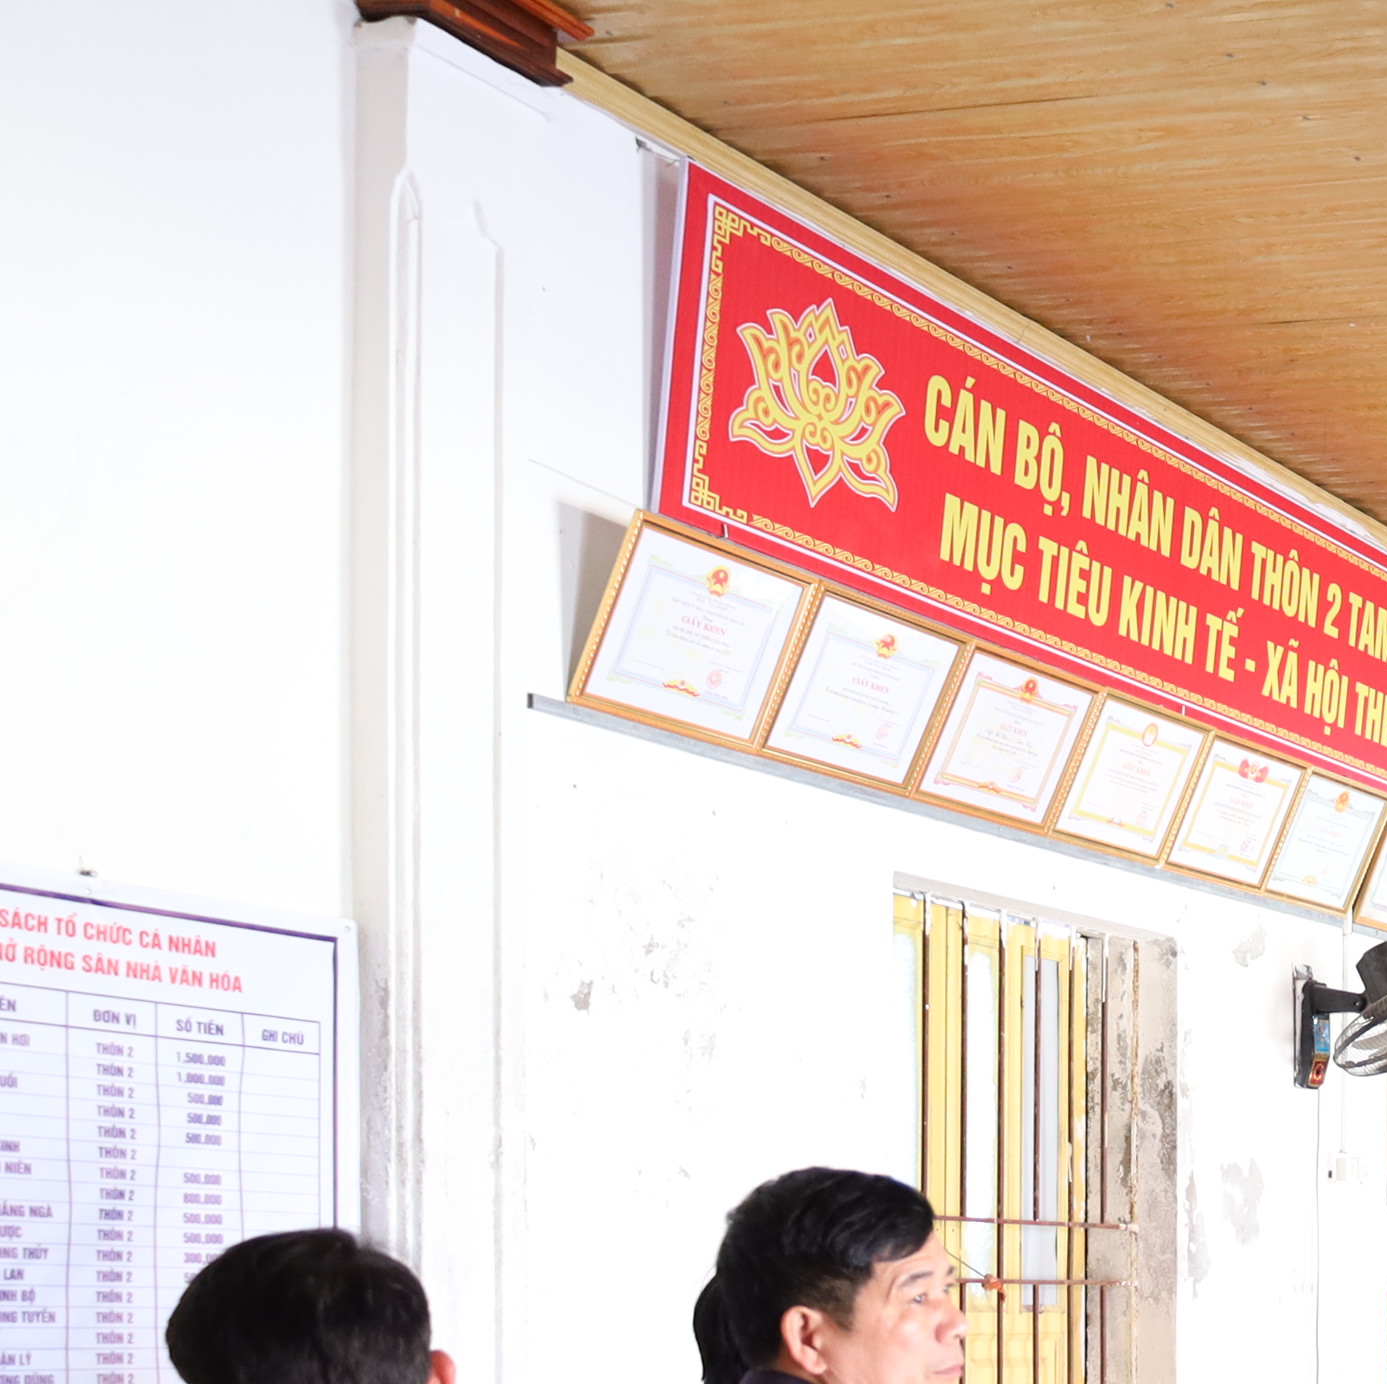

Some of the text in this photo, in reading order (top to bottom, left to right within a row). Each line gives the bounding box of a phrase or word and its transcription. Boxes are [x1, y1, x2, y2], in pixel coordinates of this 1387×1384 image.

[924, 376, 1006, 474] CÁN
[1014, 422, 1071, 517] BỘ,
[1082, 456, 1174, 556] NHÂN
[1181, 507, 1243, 589] DÂN
[1251, 542, 1320, 626] THÔN
[1324, 583, 1342, 637] 2
[940, 494, 1026, 593] MỤC
[1039, 537, 1112, 625] TIÊU
[1119, 576, 1197, 663] KINH
[1206, 609, 1243, 680] TẾ
[1262, 639, 1299, 707] XÃ
[1304, 659, 1349, 734] HỘI
[24, 944, 243, 993] RỘNG SÂN NHÀ VĂN HÓA
[55, 913, 77, 938] TỔ
[84, 921, 133, 946] CHỨC
[139, 928, 162, 951] CÁ
[168, 934, 216, 958] NHÂN
